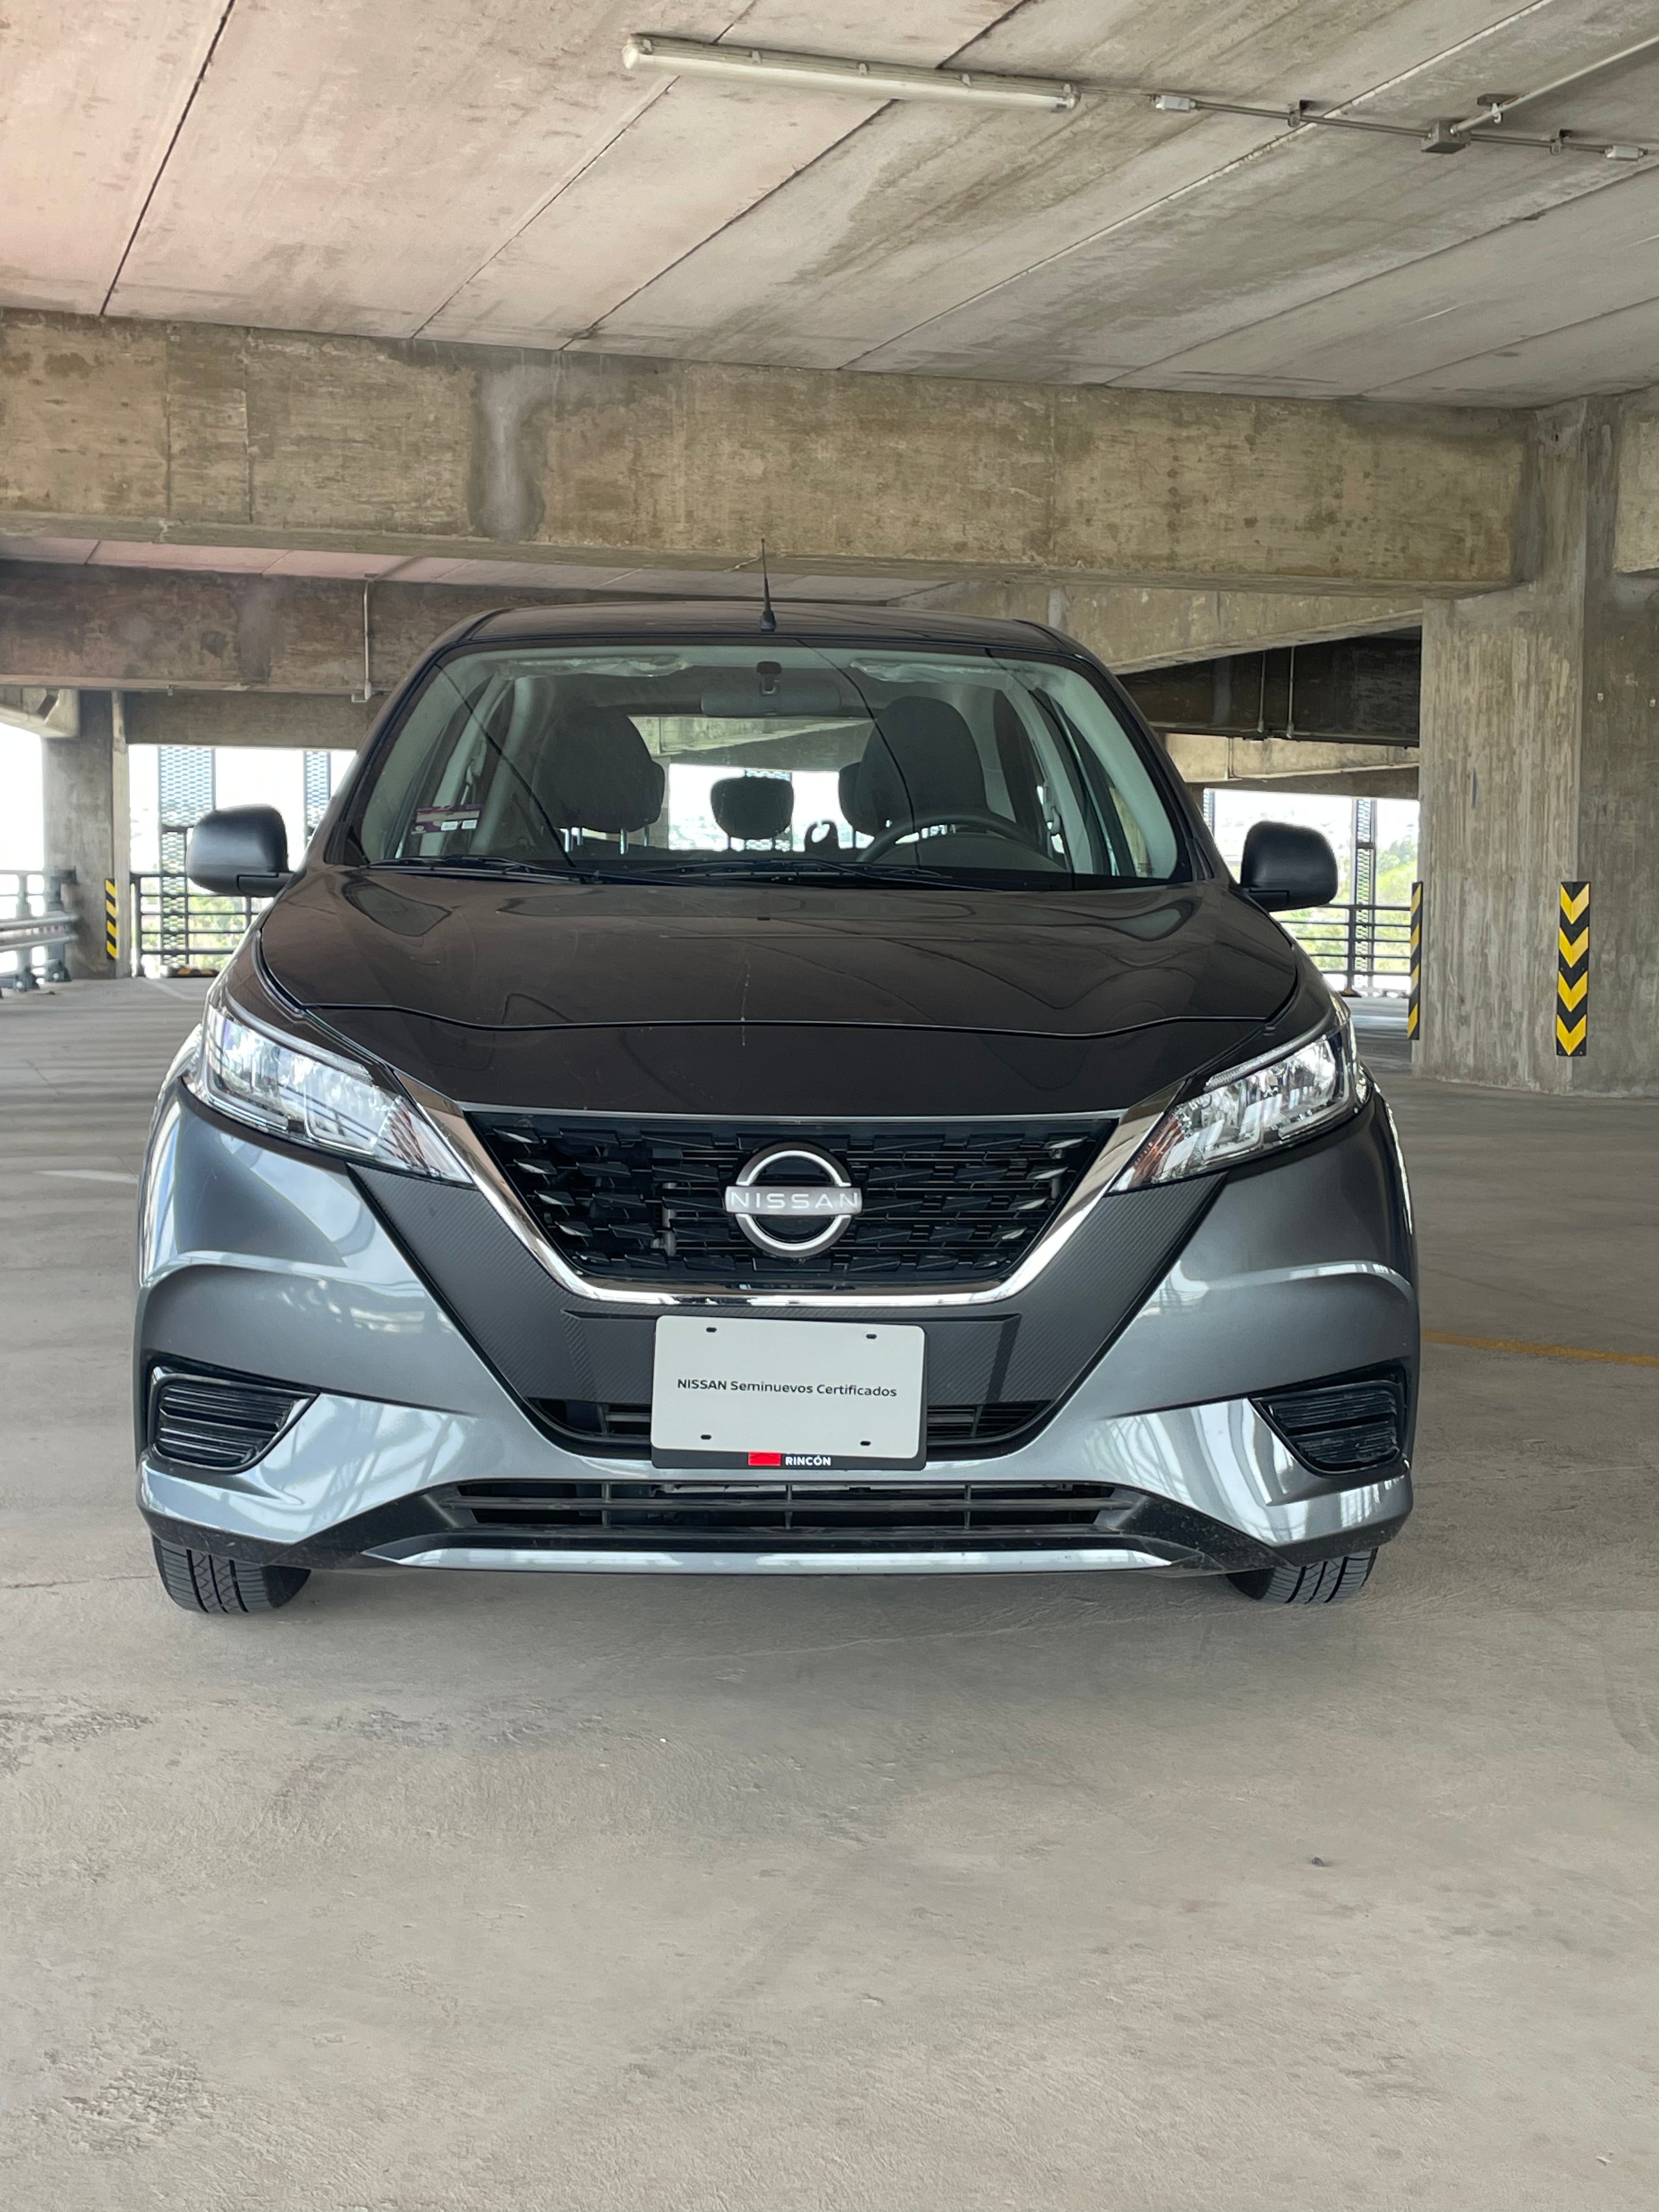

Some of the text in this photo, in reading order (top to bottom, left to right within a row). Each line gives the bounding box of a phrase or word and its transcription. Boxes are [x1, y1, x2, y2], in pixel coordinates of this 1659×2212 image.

[730, 1192, 858, 1209] NISSAN
[677, 1379, 897, 1396] NISSAN Seminuevos Certificados
[785, 1455, 831, 1466] RINCÓN
